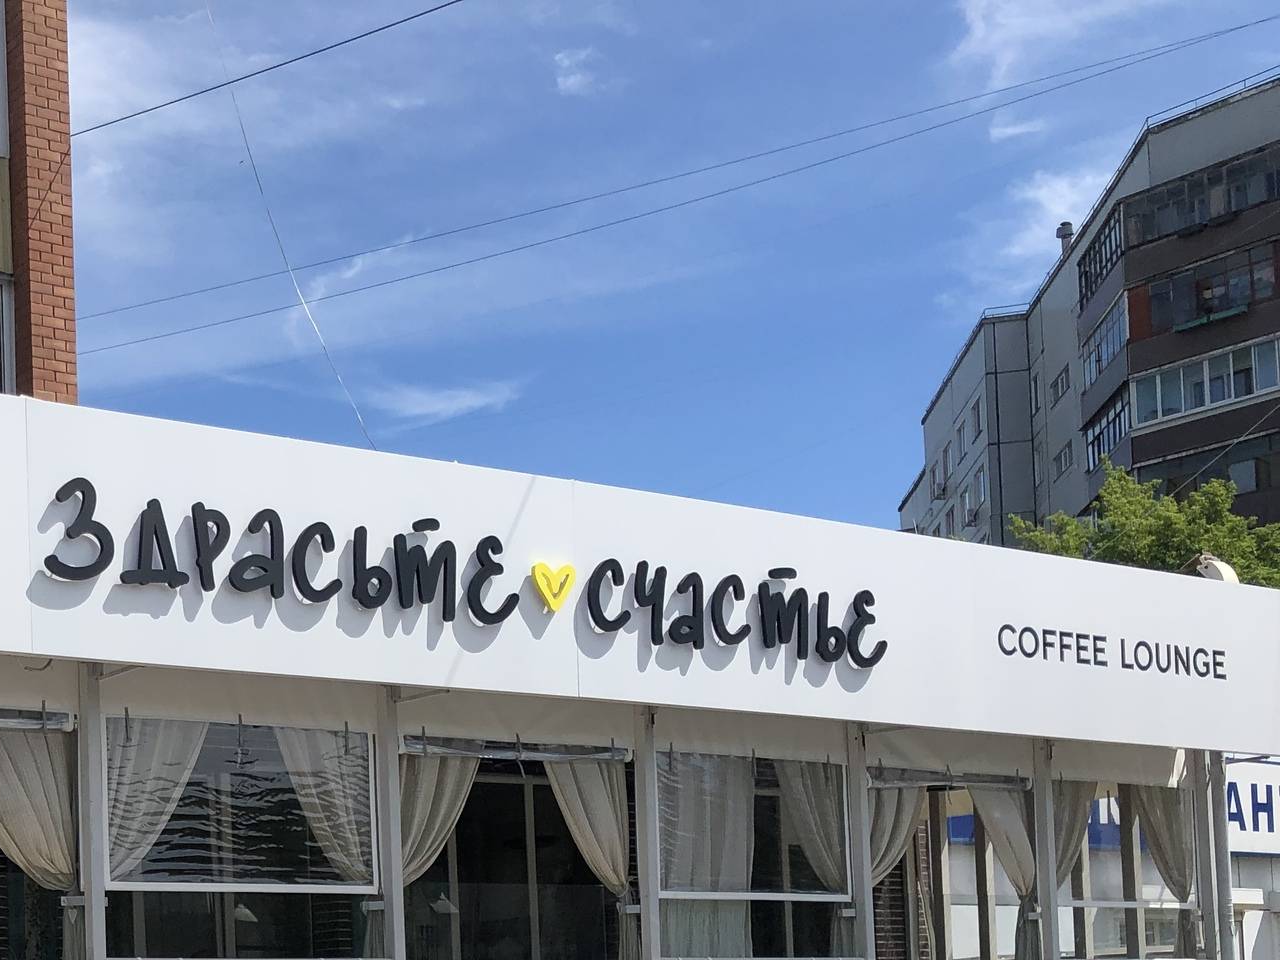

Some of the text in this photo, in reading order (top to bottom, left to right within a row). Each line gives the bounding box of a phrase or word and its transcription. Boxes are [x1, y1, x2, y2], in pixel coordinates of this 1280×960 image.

[997, 623, 1228, 681] COFFEE LOUNGE
[1227, 781, 1280, 833] АН
